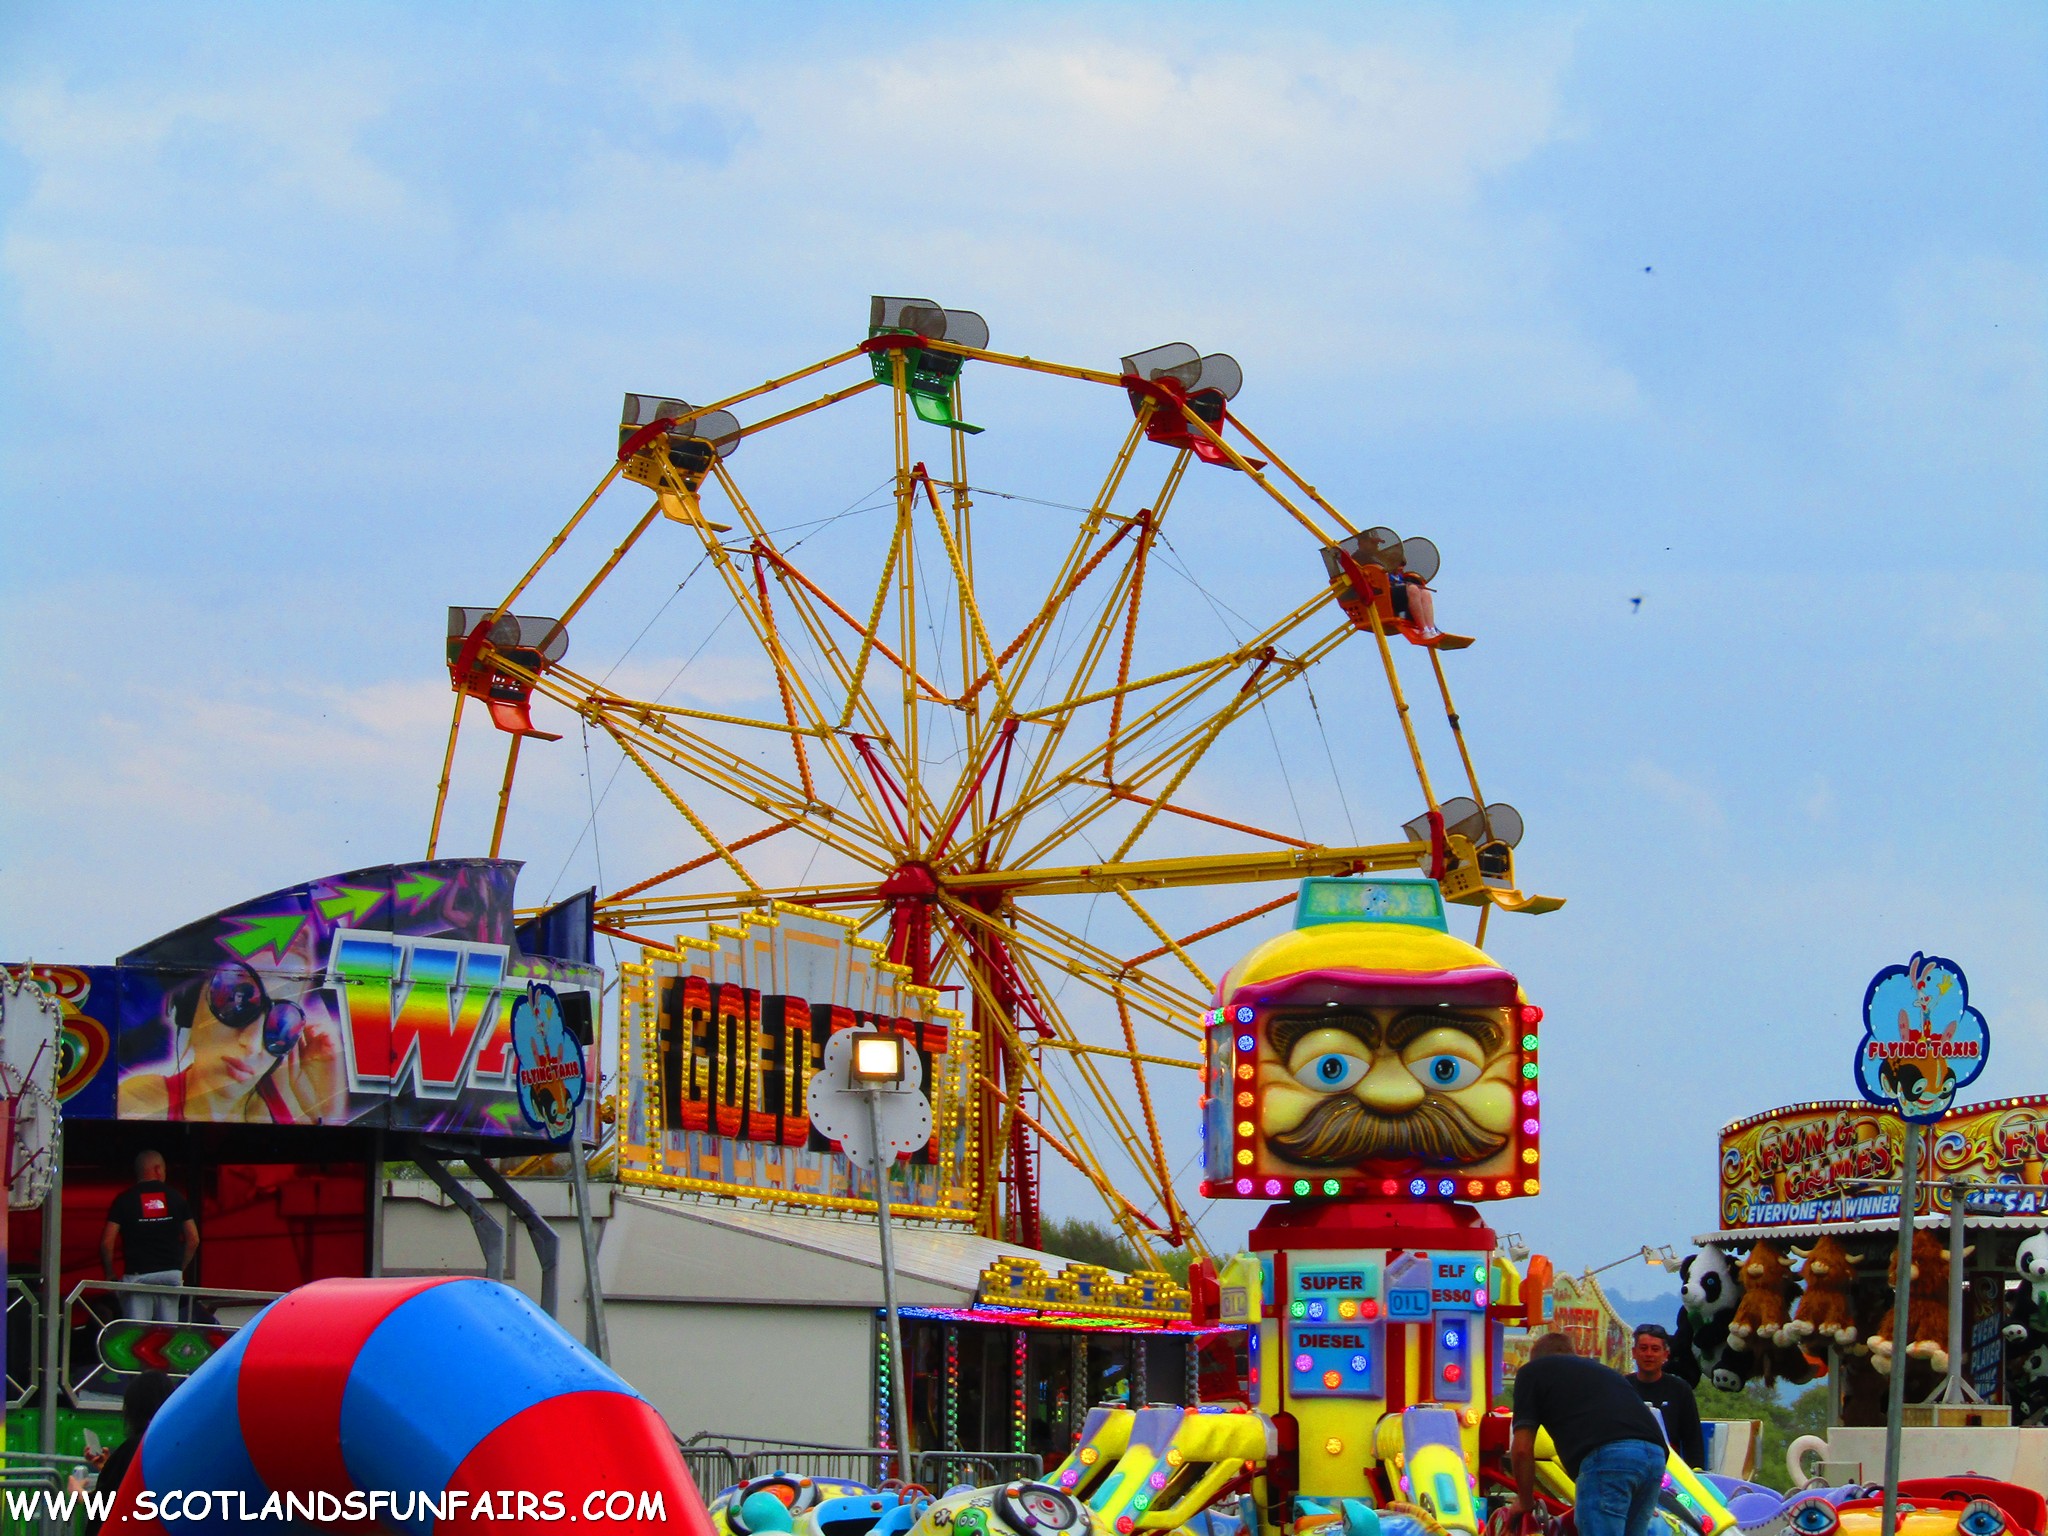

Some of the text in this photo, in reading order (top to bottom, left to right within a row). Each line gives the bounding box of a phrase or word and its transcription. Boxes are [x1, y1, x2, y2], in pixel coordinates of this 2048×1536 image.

[1868, 1040, 1979, 1059] FLYING TAXIS
[680, 975, 812, 1148] GOLD
[521, 1061, 580, 1086] FLYING TAXIS
[1760, 1119, 1829, 1179] FUN
[1783, 1133, 1893, 1205] GAMES
[1747, 1194, 1902, 1225] EVERYONE'S A WINNER
[2018, 1191, 2036, 1213] A
[1438, 1264, 1466, 1278] ELF
[1301, 1276, 1363, 1291] SUPER
[1223, 1296, 1246, 1313] OIL
[1392, 1296, 1423, 1311] OIL
[1431, 1288, 1472, 1303] ESSO
[1299, 1334, 1365, 1349] DIESEL
[1971, 1313, 2001, 1348] EVERY
[1970, 1339, 2002, 1375] PLAYER
